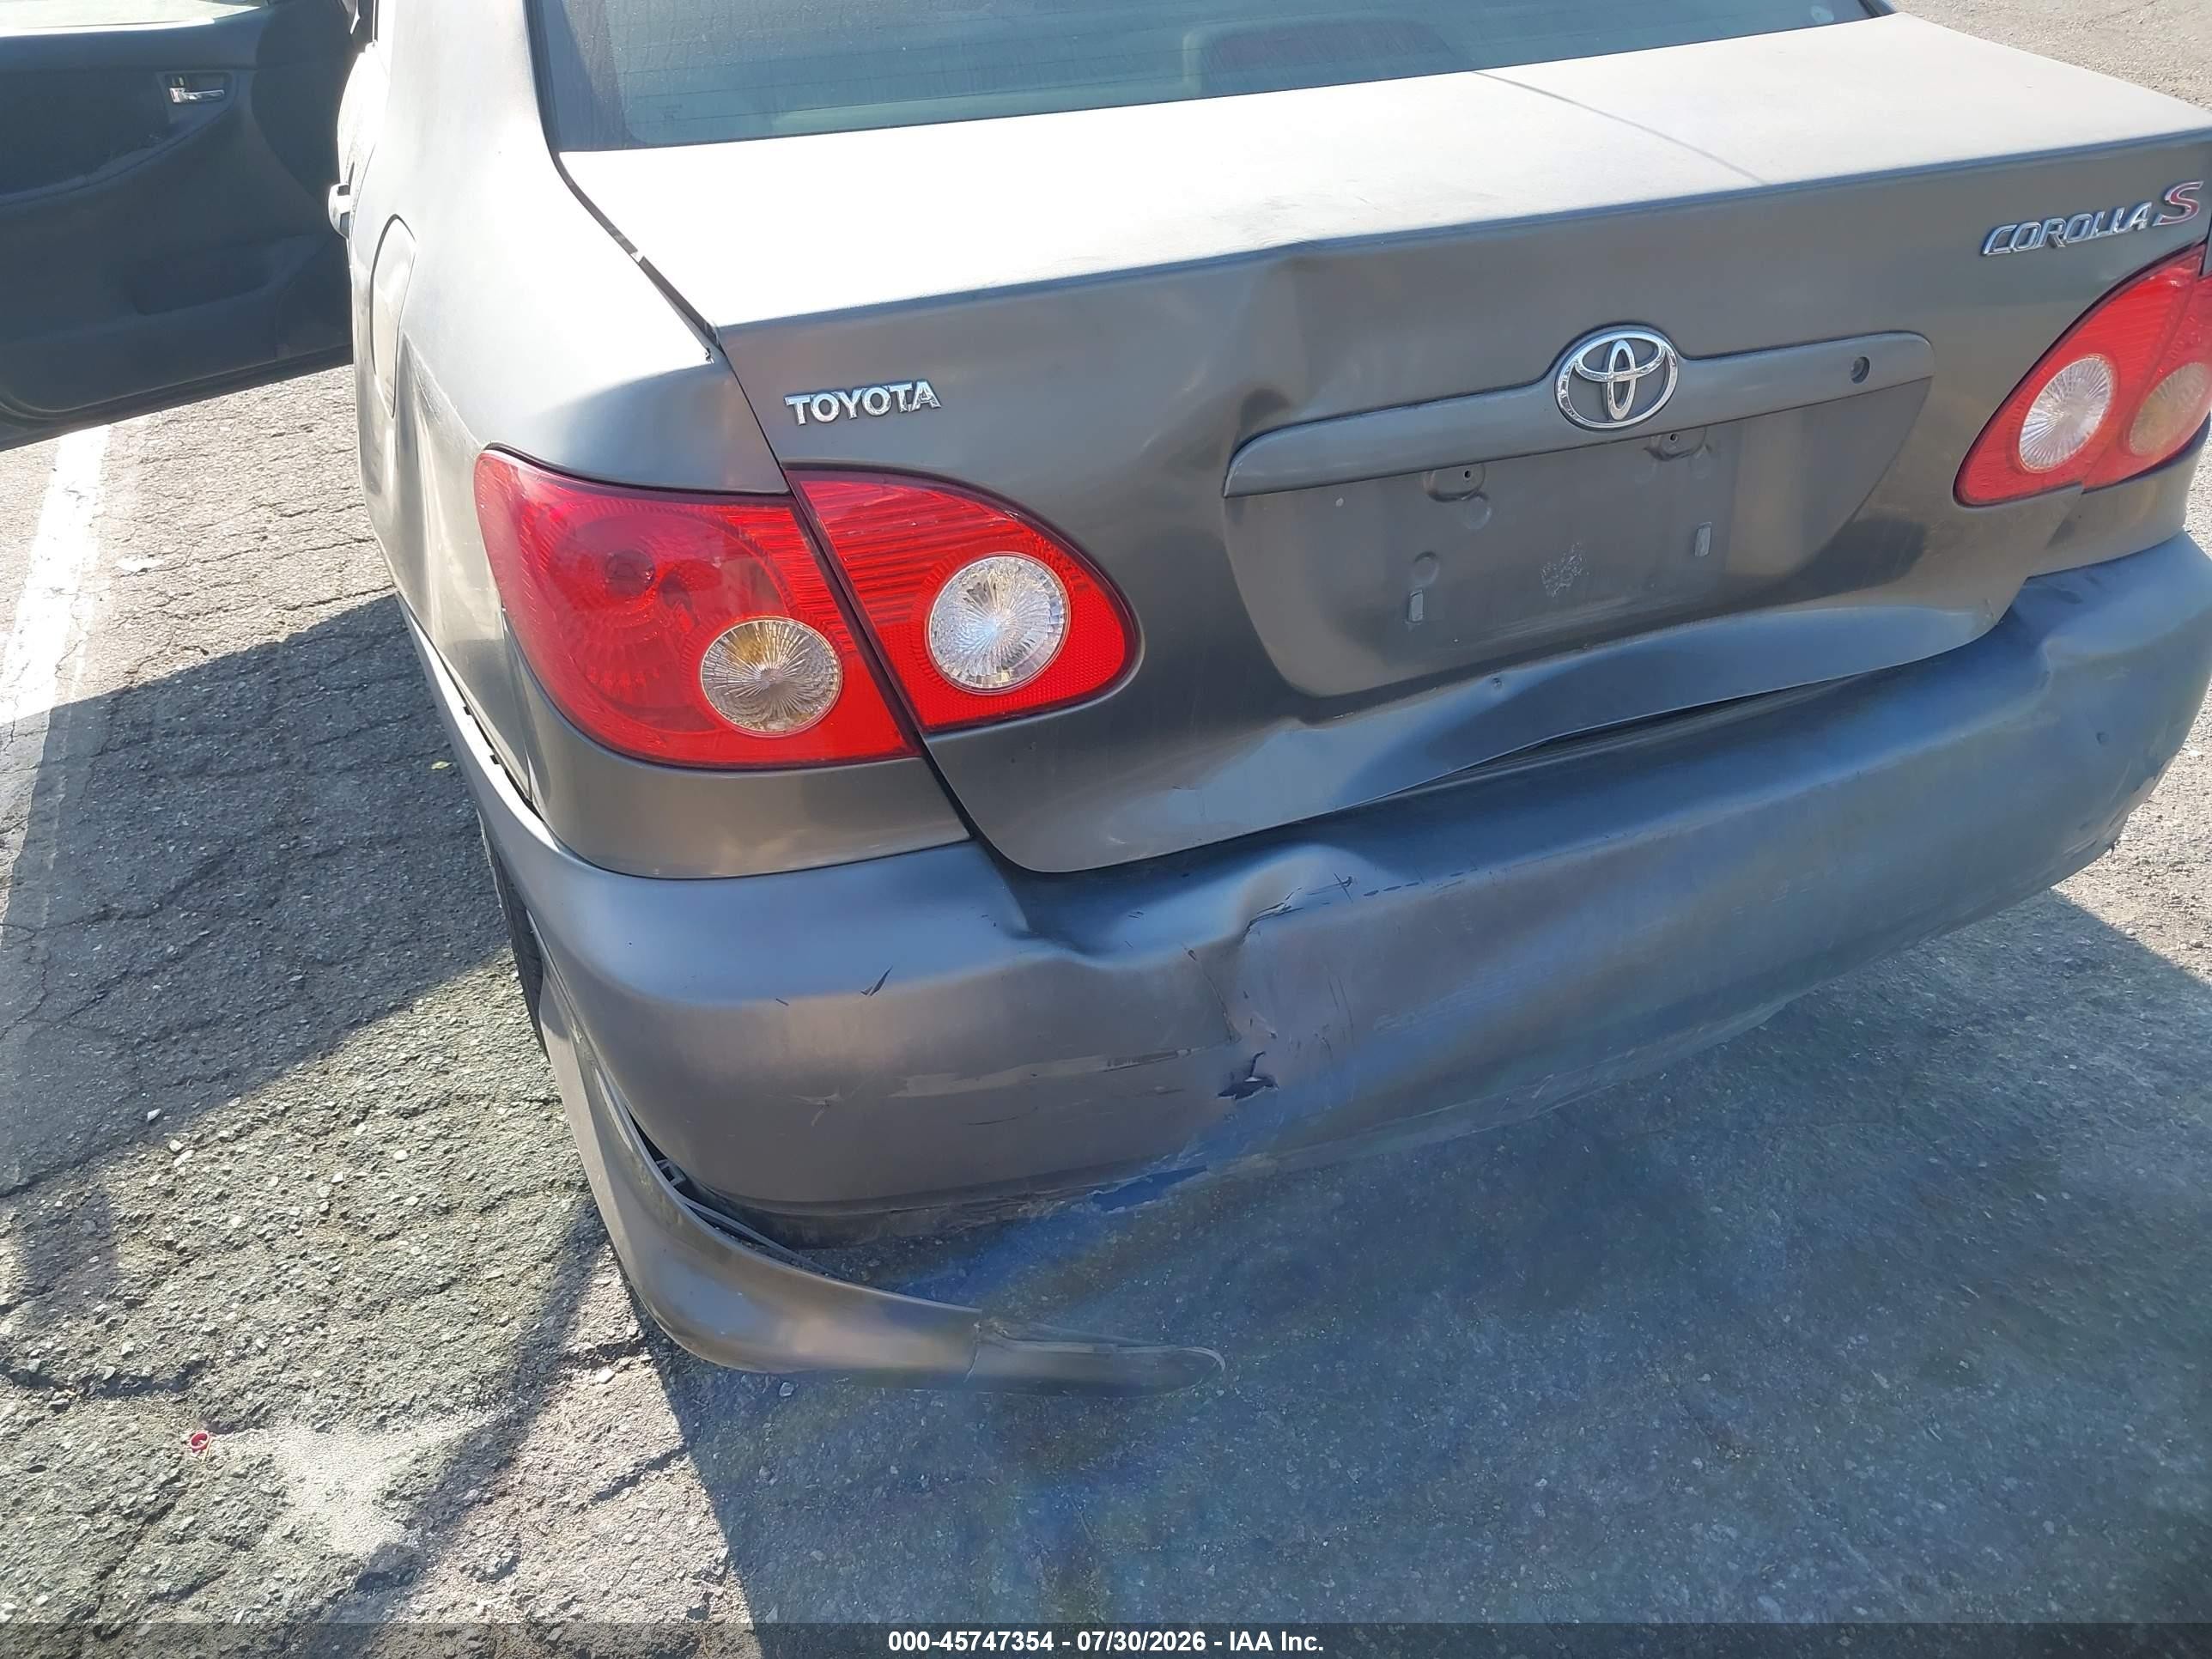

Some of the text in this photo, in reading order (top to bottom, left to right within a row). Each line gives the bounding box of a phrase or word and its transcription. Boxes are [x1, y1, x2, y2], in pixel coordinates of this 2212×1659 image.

[1982, 180, 2204, 256] COROLLA S
[784, 380, 941, 426] TOYOTA
